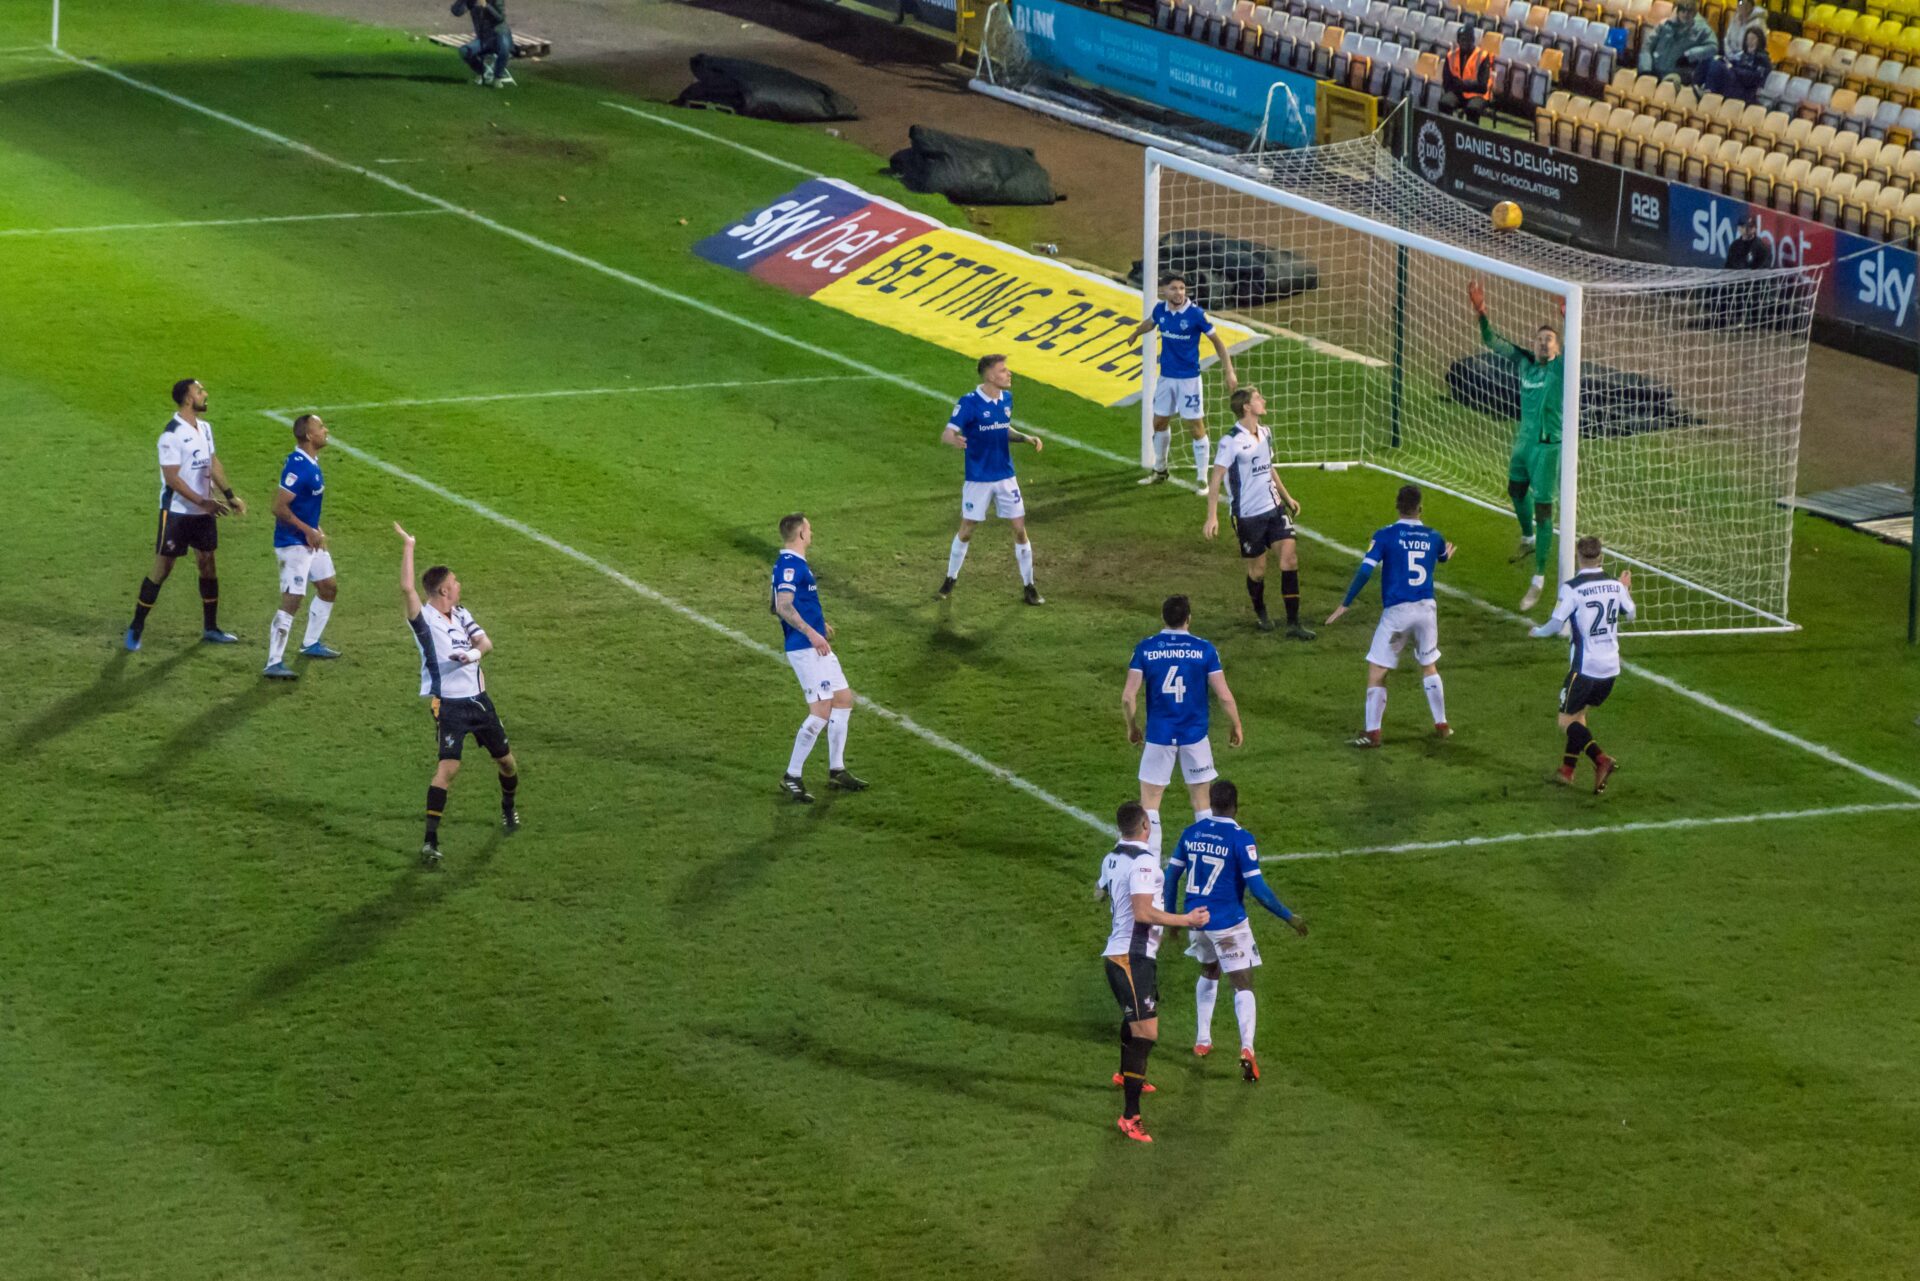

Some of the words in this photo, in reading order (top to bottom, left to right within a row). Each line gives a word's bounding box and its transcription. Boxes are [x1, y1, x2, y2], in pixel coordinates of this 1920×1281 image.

[1016, 4, 1055, 40] BLINK
[1455, 132, 1511, 164] DANIEL'S
[1514, 149, 1579, 184] DELIGHTS
[1473, 163, 1501, 181] FAMILY
[1501, 172, 1561, 200] CHOCOLATIERS
[1631, 191, 1661, 221] A2B
[727, 194, 836, 260] sky
[786, 211, 907, 274] bet
[1859, 250, 1916, 327] sky
[1184, 394, 1200, 408] 23
[1011, 489, 1021, 504] 3
[1403, 539, 1431, 551] LYDEN
[1407, 551, 1427, 587] 5
[1582, 584, 1620, 597] WHITFIELD
[1585, 598, 1617, 637] 24
[1147, 649, 1203, 661] EDMUNDSON
[1161, 665, 1187, 704] 4
[1187, 840, 1229, 857] MISSILOU
[1185, 852, 1225, 896] 17
